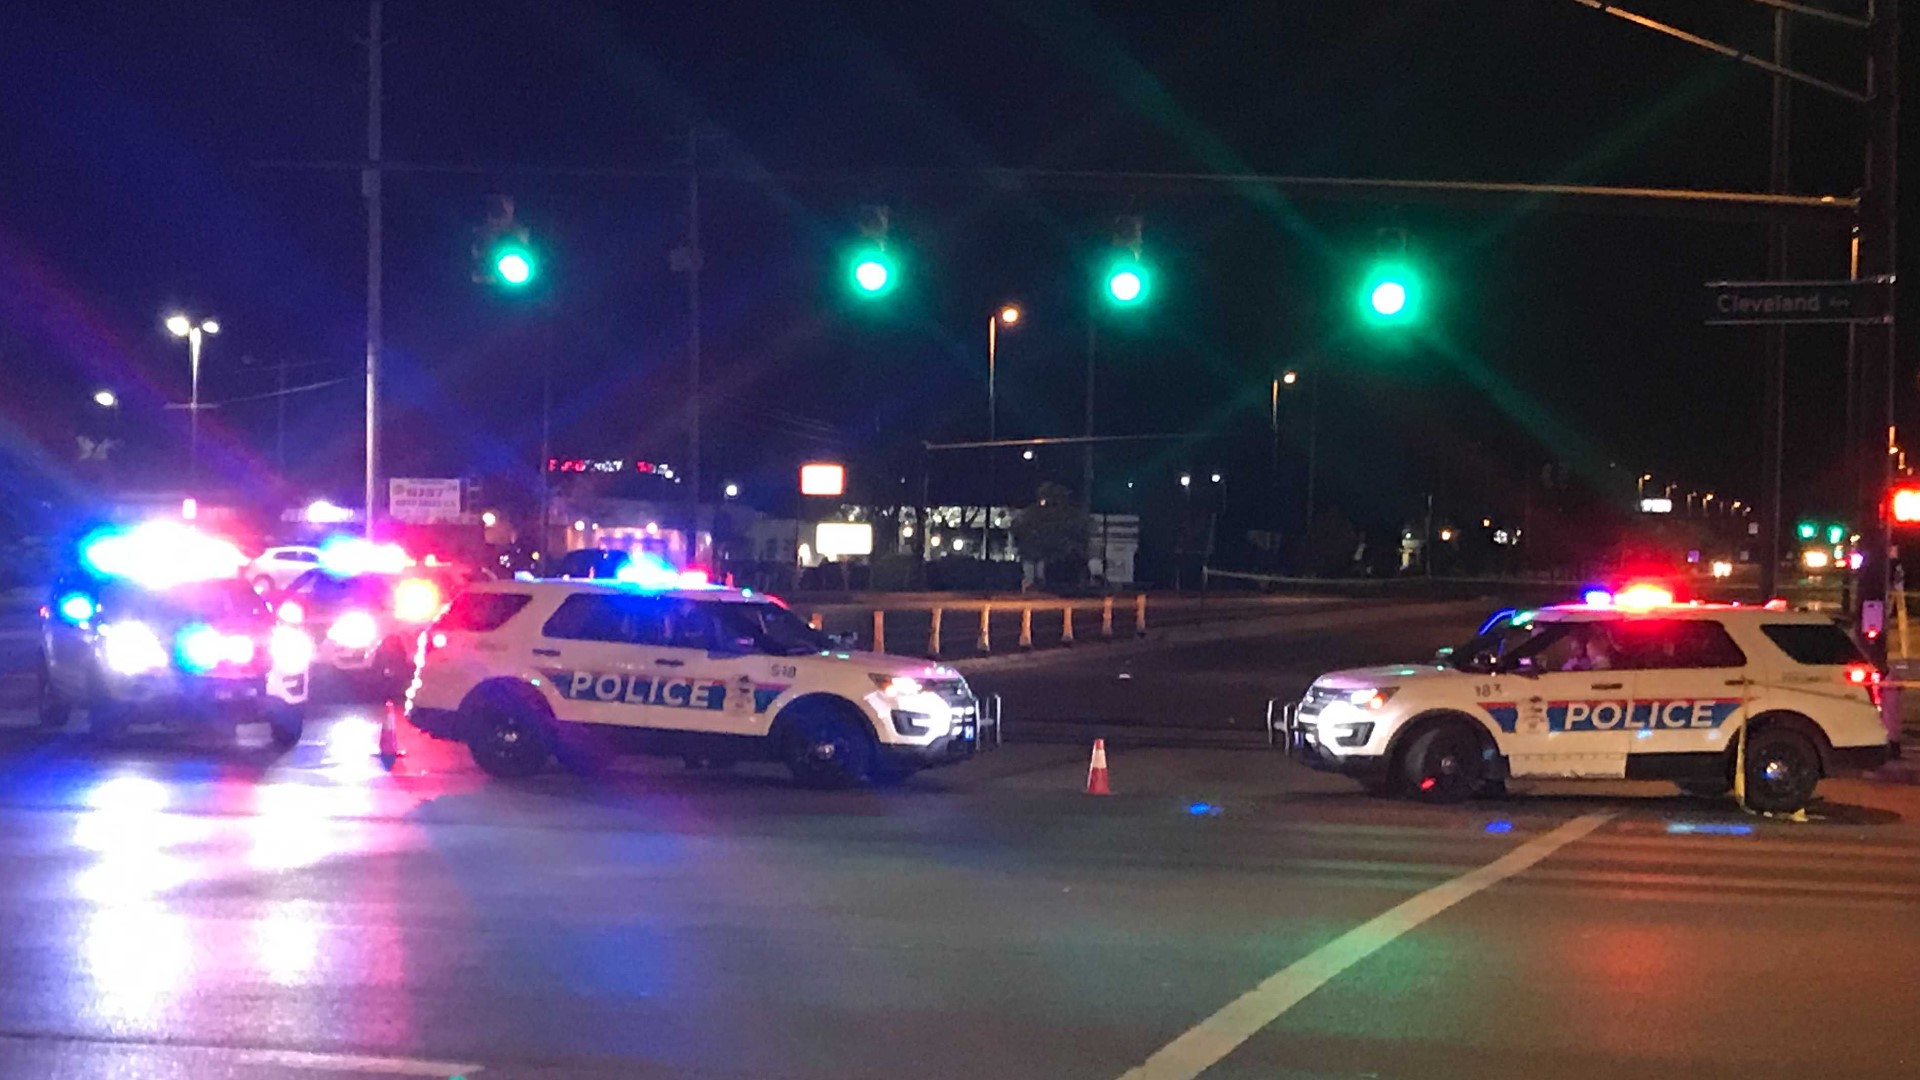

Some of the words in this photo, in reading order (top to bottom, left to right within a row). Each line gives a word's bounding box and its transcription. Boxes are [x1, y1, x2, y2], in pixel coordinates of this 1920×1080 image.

[1717, 293, 1820, 312] Cleveland
[570, 671, 710, 707] POLICE
[1564, 700, 1717, 731] POLICE
